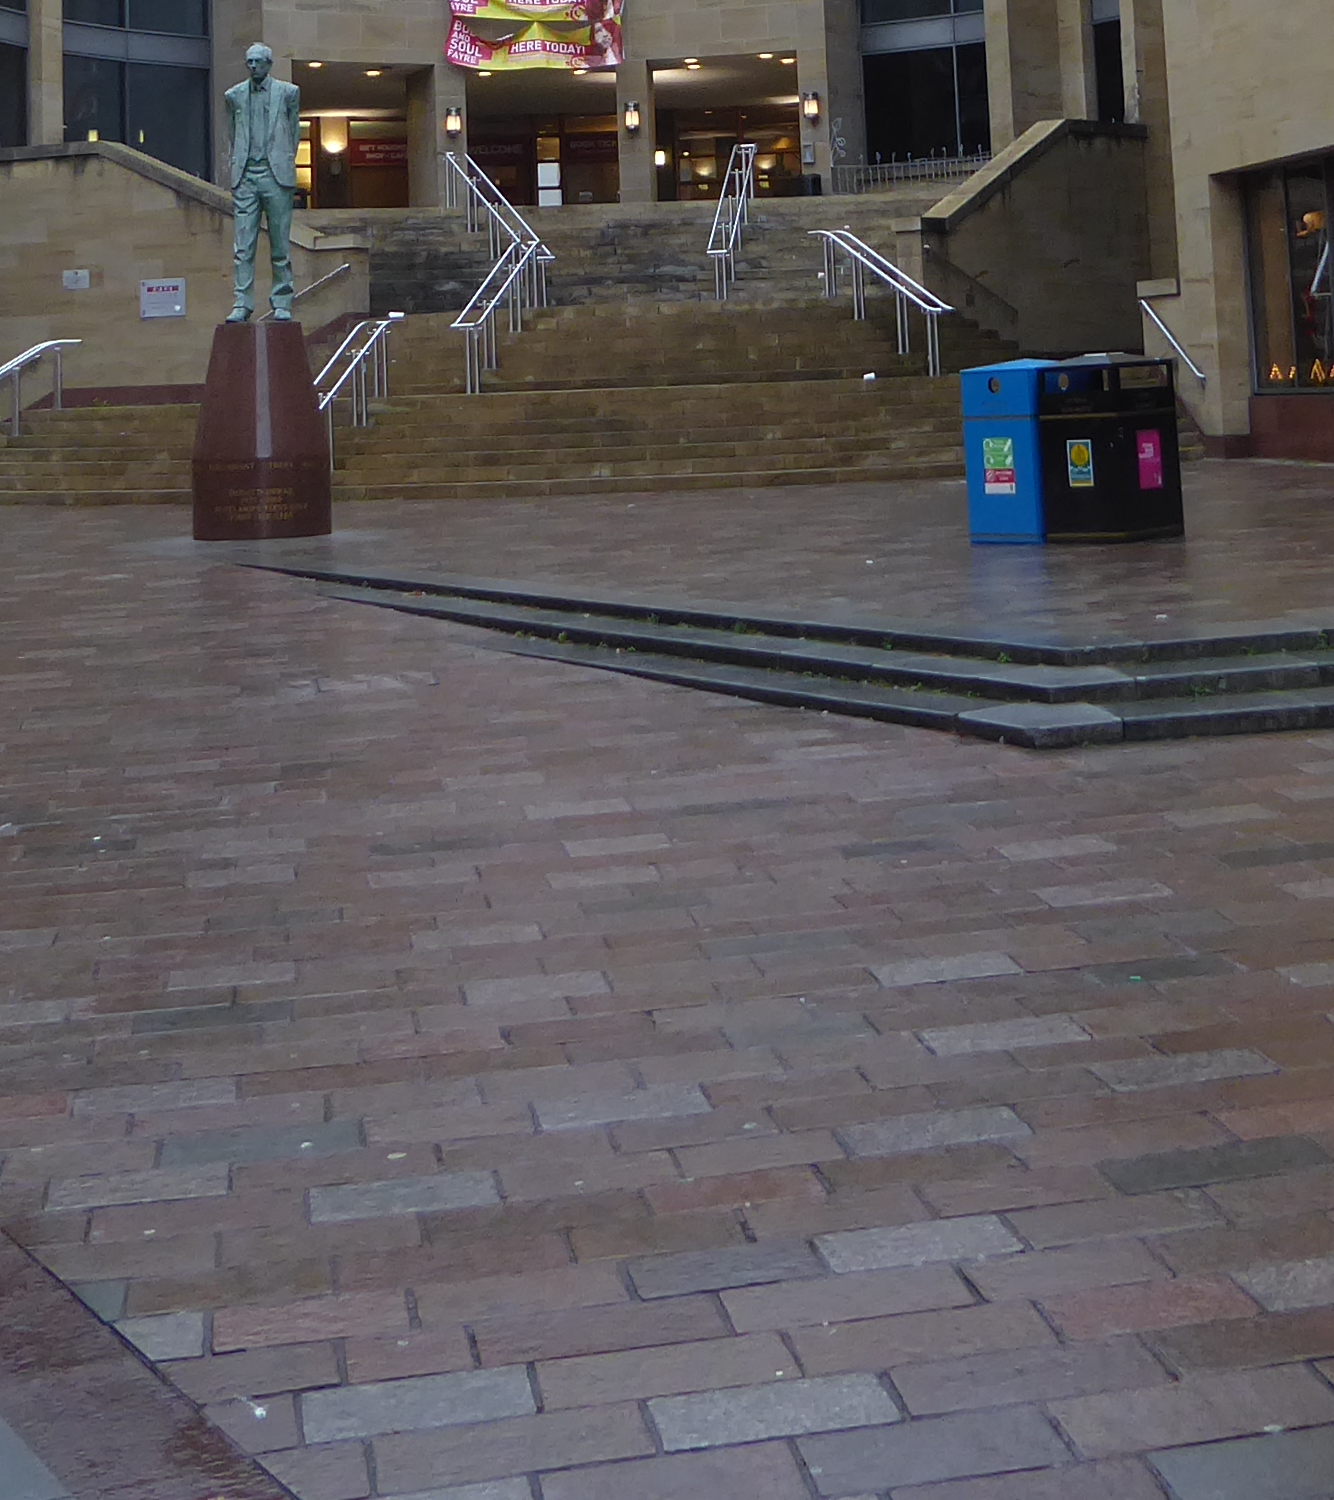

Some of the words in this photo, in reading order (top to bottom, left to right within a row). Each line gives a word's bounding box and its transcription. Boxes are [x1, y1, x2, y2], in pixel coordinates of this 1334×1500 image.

[451, 31, 471, 43] AND
[449, 38, 483, 57] SOUL
[510, 41, 542, 53] HERE
[544, 40, 586, 55] TODAY!
[446, 48, 477, 64] FAYRE
